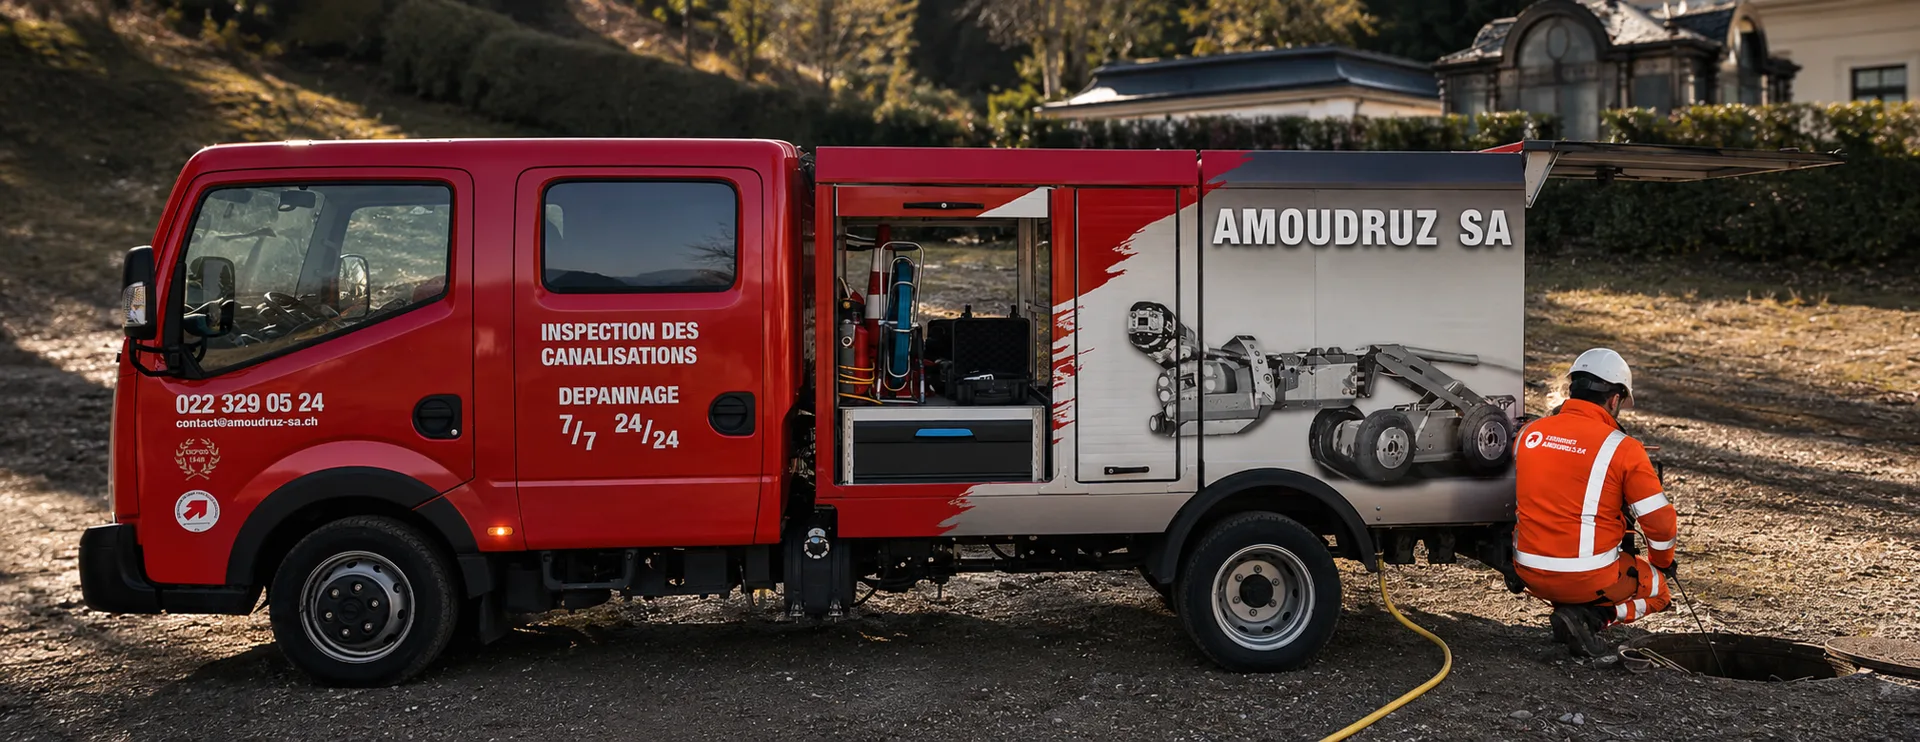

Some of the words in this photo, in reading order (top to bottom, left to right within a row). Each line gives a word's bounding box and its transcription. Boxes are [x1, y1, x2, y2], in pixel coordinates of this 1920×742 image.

[1212, 208, 1438, 246] AMOUDRUZ
[1460, 209, 1512, 246] SA
[541, 322, 655, 341] INSPECTION
[661, 321, 699, 340] DES
[541, 346, 698, 366] CANALISATIONS
[175, 394, 215, 414] 022
[221, 393, 261, 413] 329
[266, 392, 292, 413] 05
[298, 392, 325, 412] 24
[558, 385, 680, 405] DEPANNAGE
[175, 416, 318, 428] contact@amoudruz-sa.ch
